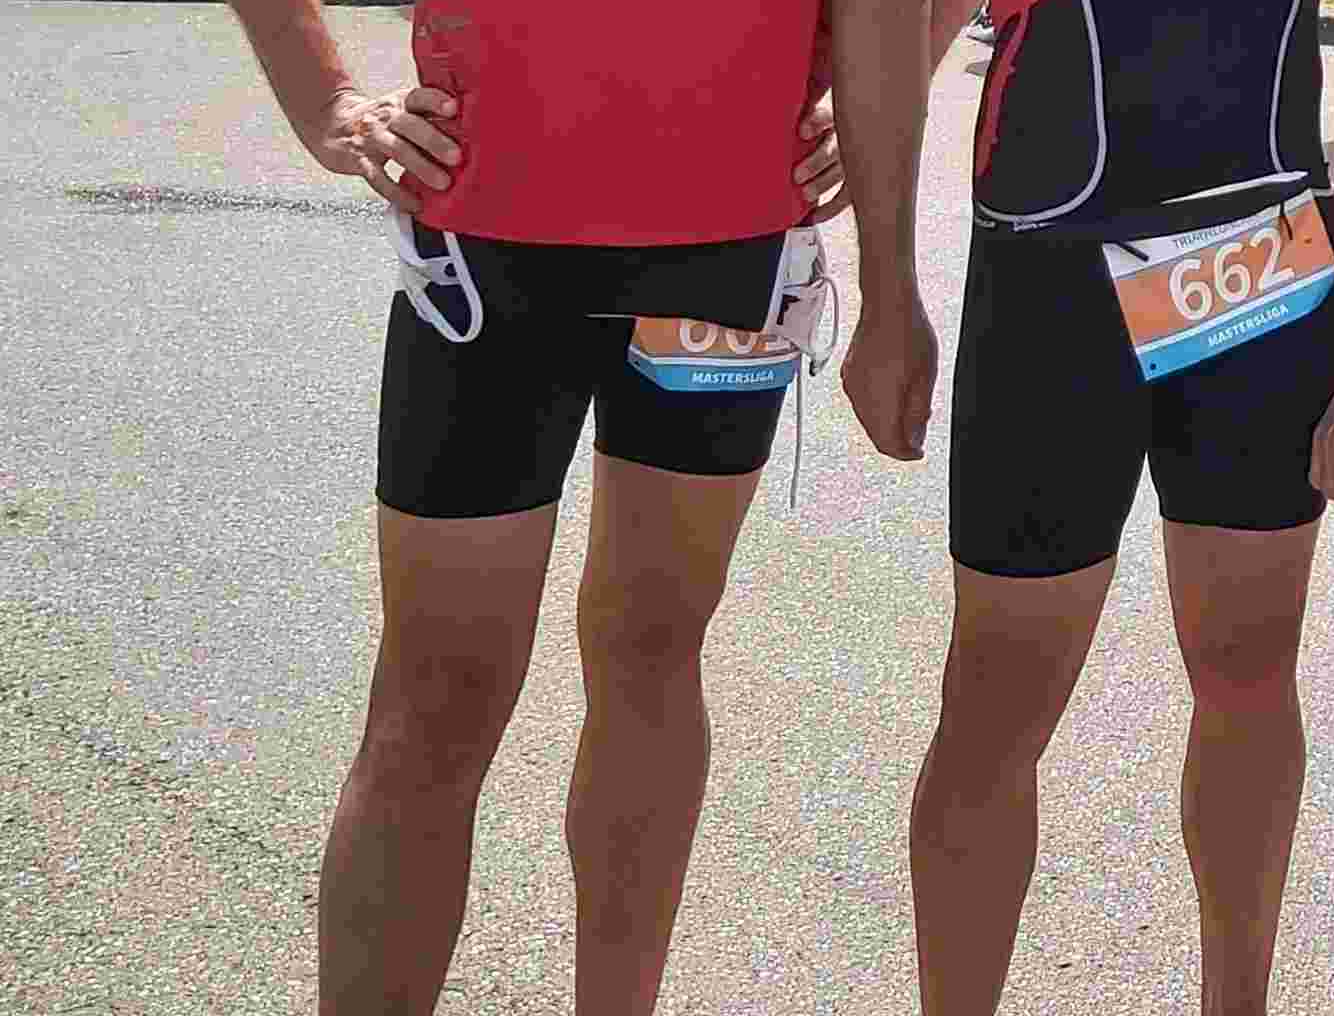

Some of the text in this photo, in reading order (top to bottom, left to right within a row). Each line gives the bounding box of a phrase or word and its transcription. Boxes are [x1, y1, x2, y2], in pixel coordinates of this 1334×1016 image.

[1169, 227, 1295, 321] 662
[1207, 304, 1290, 347] MASTERSLIGA
[692, 370, 775, 385] MASTERSLIGA
